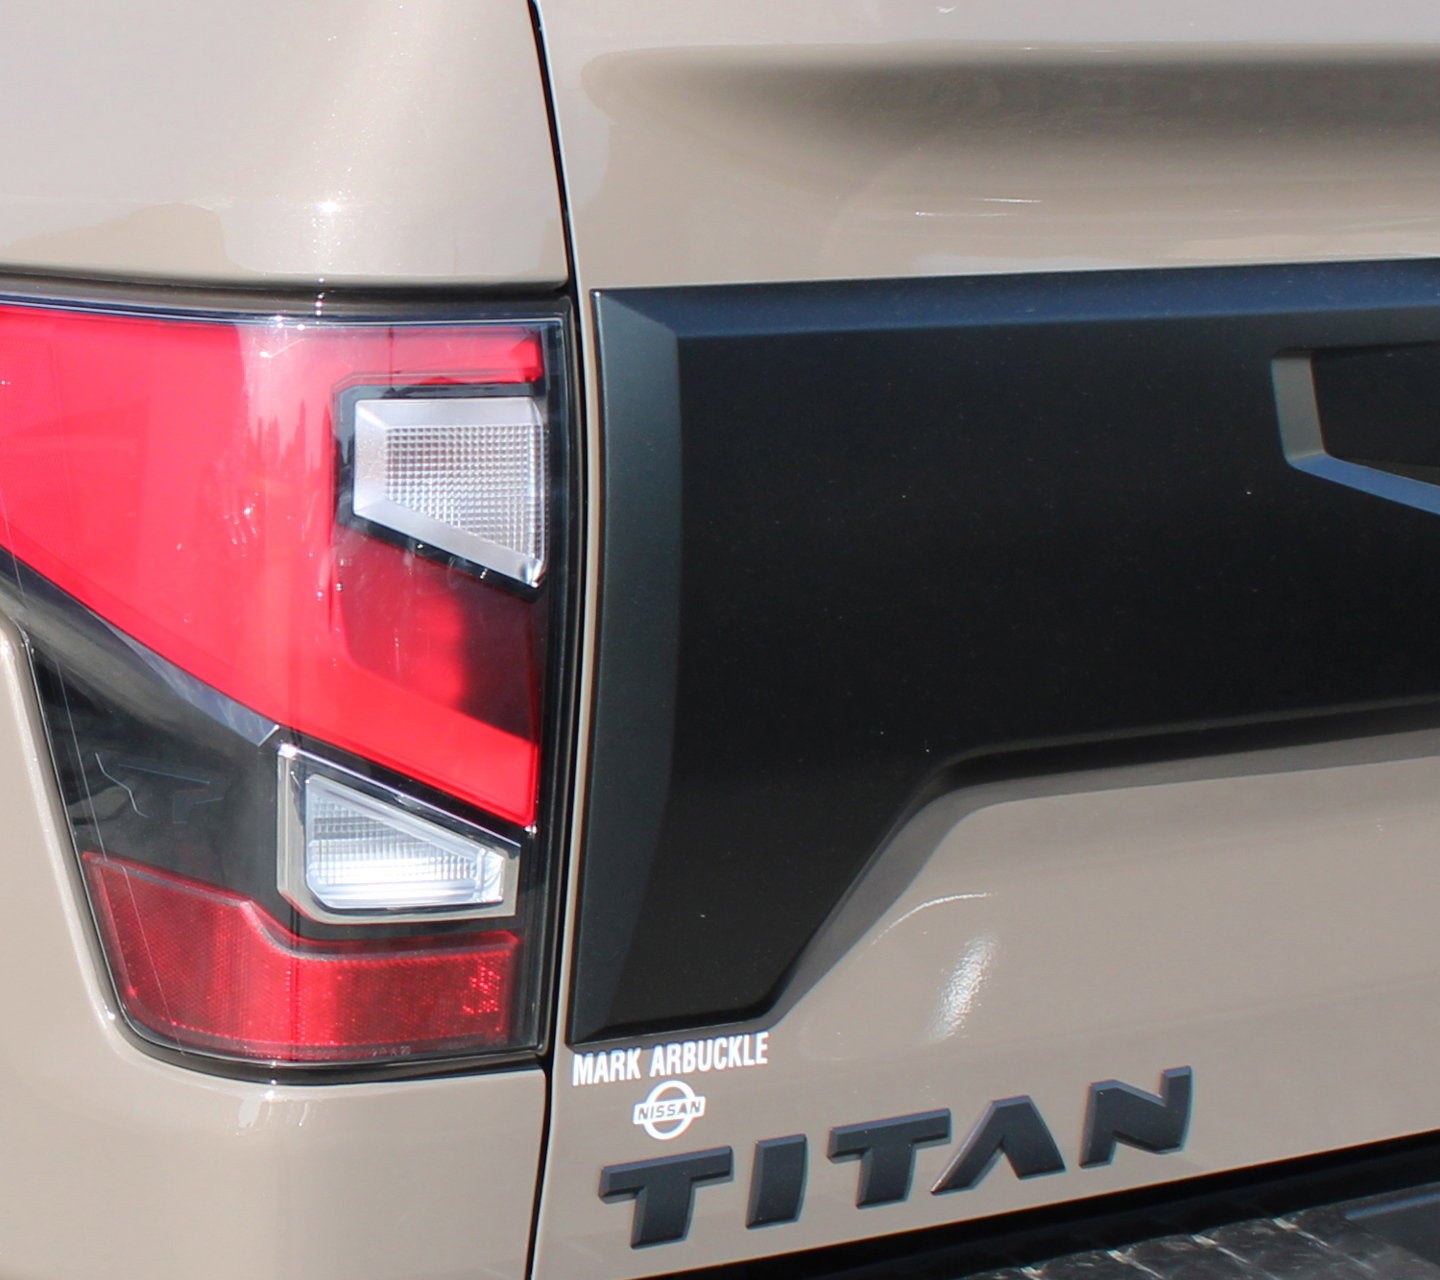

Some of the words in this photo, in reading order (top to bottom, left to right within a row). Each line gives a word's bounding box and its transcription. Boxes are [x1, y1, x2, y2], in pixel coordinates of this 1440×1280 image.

[572, 1044, 642, 1087] MARK
[649, 1031, 769, 1077] ARBUCKLE
[636, 1097, 702, 1121] NISSAN
[598, 1065, 1192, 1250] TITAN
